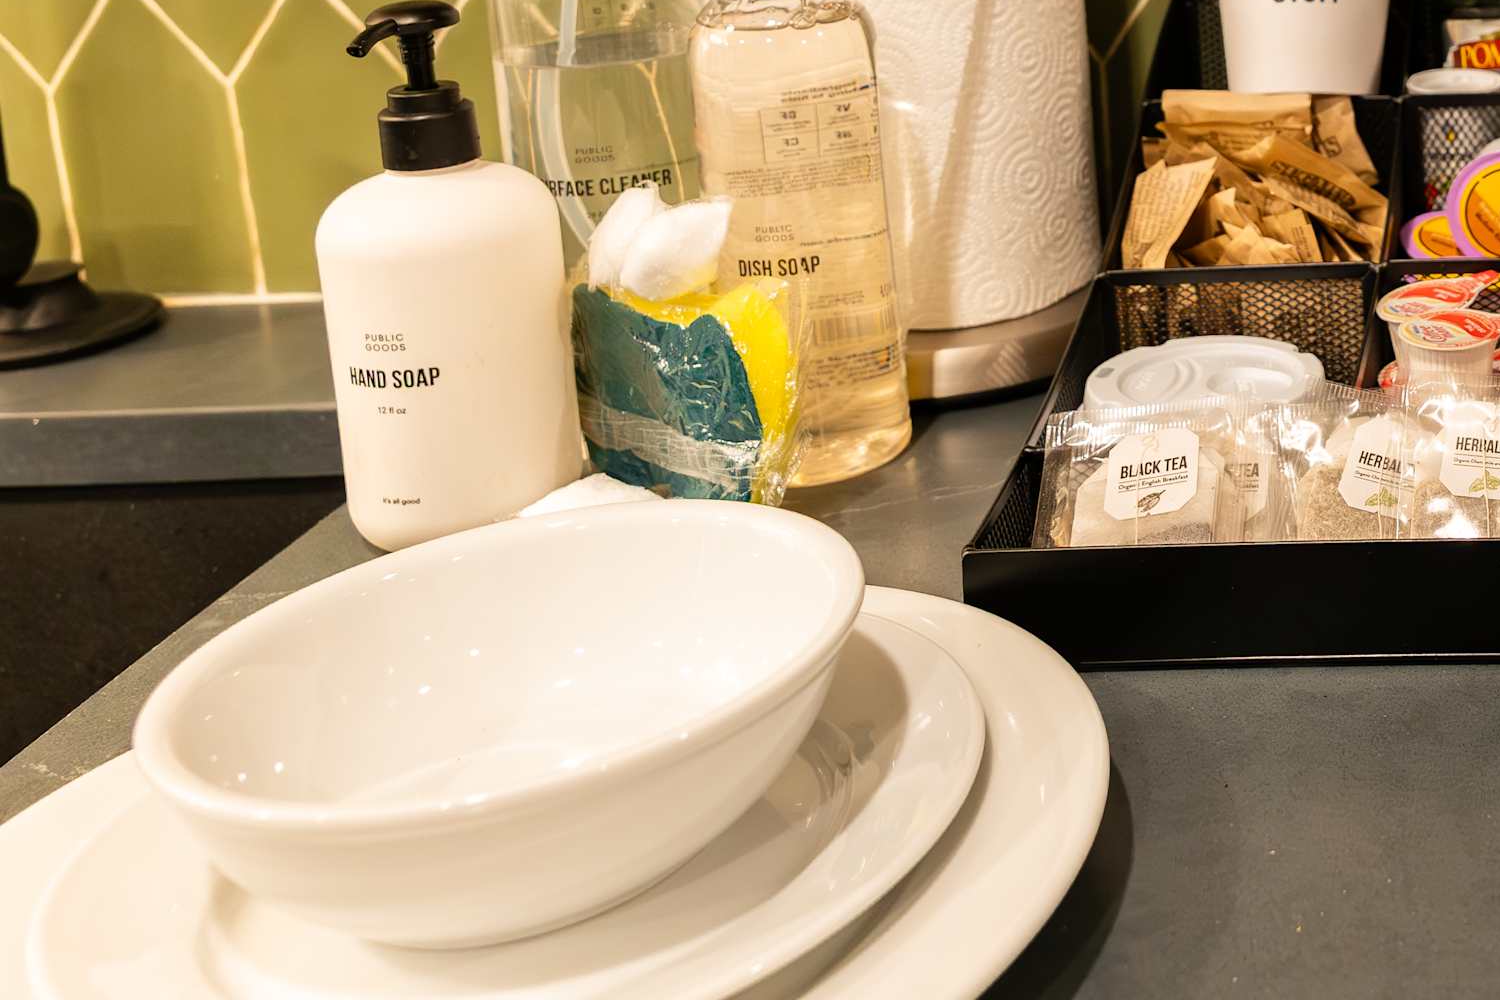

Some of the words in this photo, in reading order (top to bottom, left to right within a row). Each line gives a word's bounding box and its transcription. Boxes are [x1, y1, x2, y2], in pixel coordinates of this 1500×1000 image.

[755, 225, 793, 234] PUBLIC
[755, 233, 795, 243] GOODS
[738, 259, 772, 277] DISH
[778, 255, 820, 276] SOAP
[365, 333, 404, 342] PUBLIC
[365, 343, 406, 352] GOODS
[349, 366, 386, 389] HAND
[392, 367, 440, 389] SOAP
[1455, 436, 1500, 454] HERBAL
[1120, 460, 1161, 479] BLACK
[1164, 455, 1187, 472] TEA
[1358, 450, 1402, 474] HERBAL
